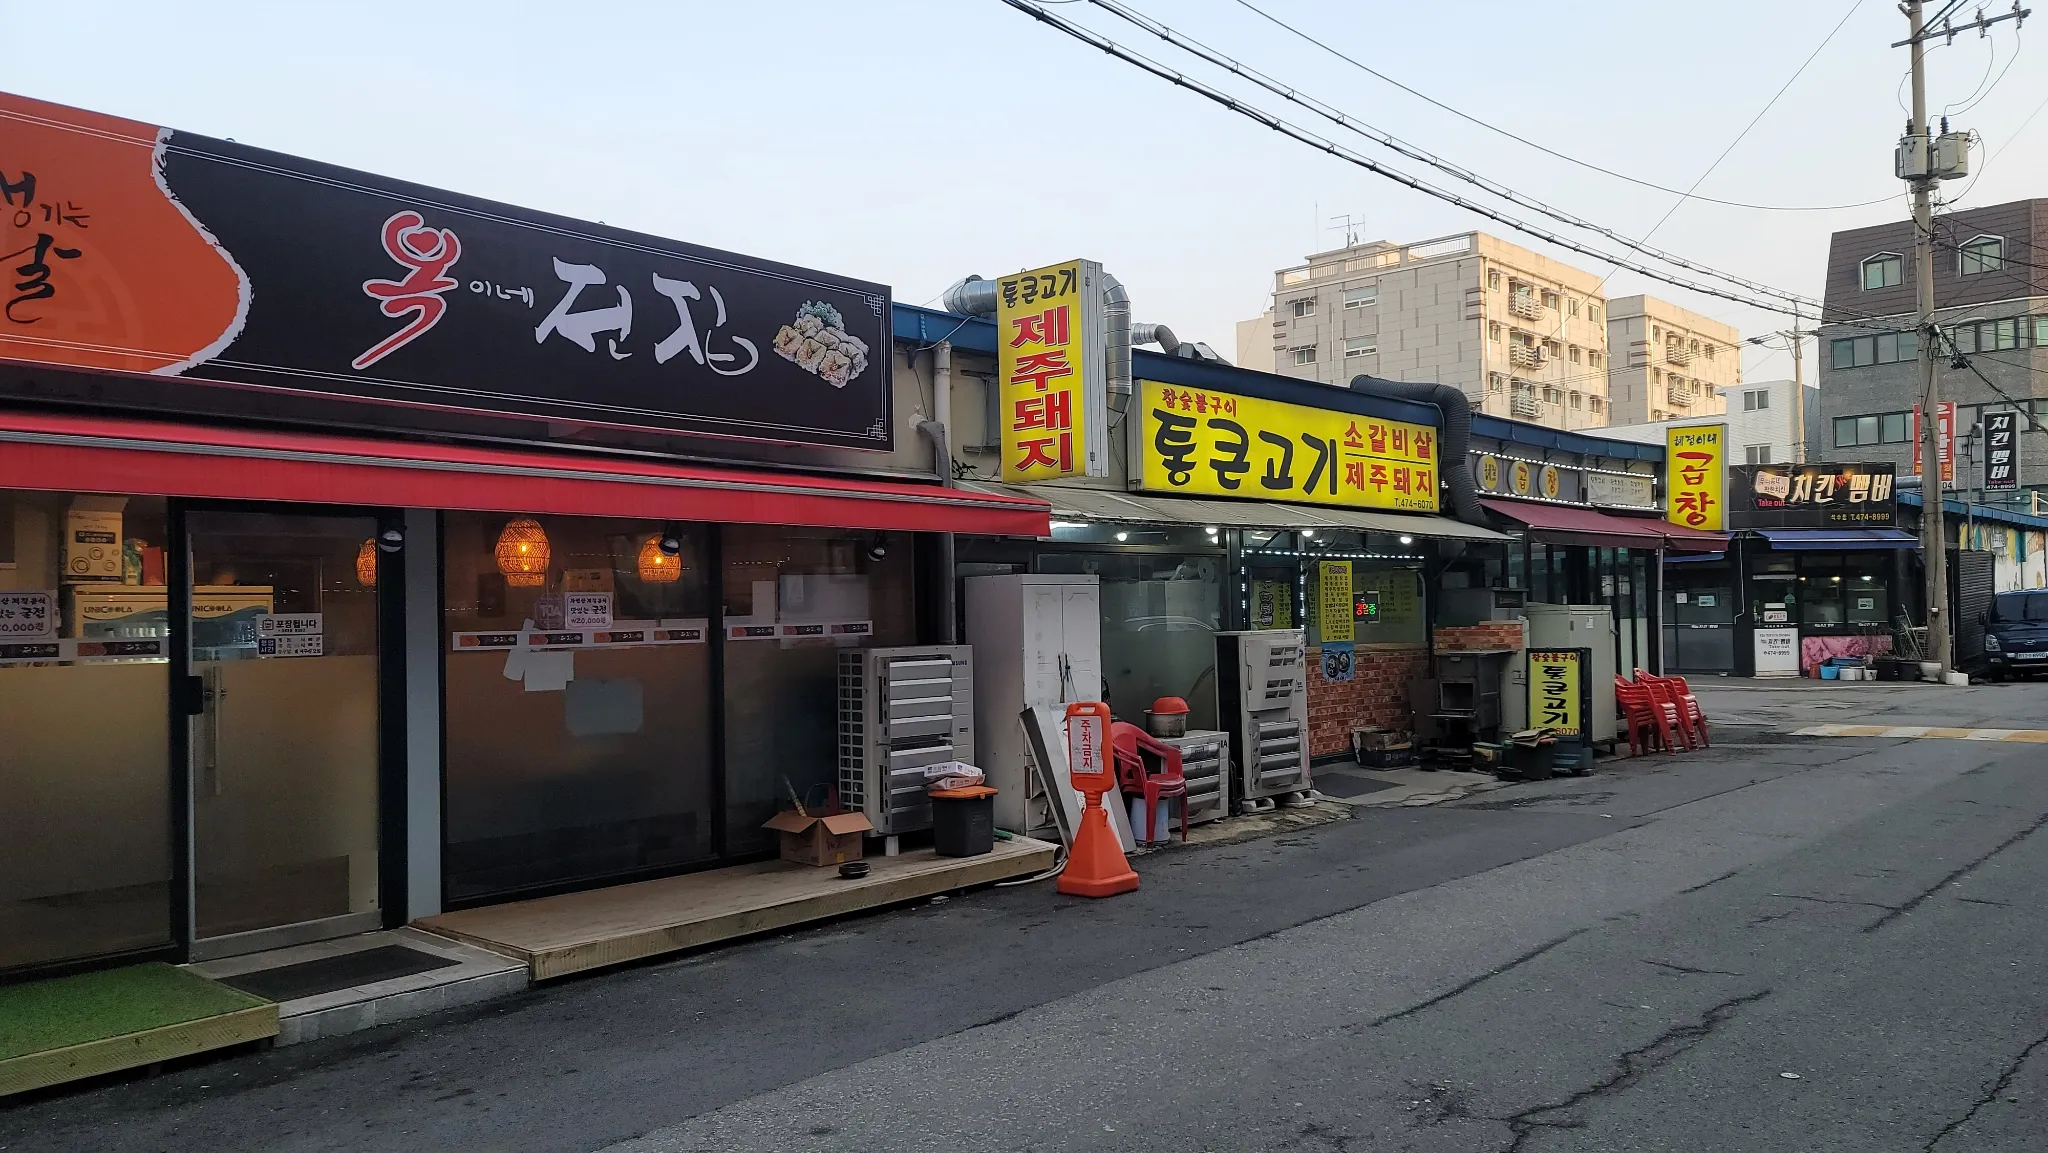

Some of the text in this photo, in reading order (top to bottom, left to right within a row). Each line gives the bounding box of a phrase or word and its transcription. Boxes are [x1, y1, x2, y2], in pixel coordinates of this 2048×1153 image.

[1002, 267, 1077, 309] 통큰고기
[1009, 304, 1074, 473] 제주돼지
[1162, 387, 1237, 418] 참숯불구이
[1344, 420, 1432, 460] 소갈비살
[1988, 416, 2010, 446] 치킨
[1152, 408, 1338, 496] 통큰고기
[1345, 461, 1433, 498] 제주돼지
[1675, 451, 1716, 526] 곱창
[1790, 474, 1836, 504] 치킨
[1394, 497, 1434, 510] T.474-6070
[1758, 498, 1785, 507] Take out
[276, 619, 317, 629] 포장됩니다
[1531, 652, 1578, 662] 참숯불구이
[1541, 665, 1569, 725] 통큰고기
[1081, 719, 1093, 769] 주차금지
